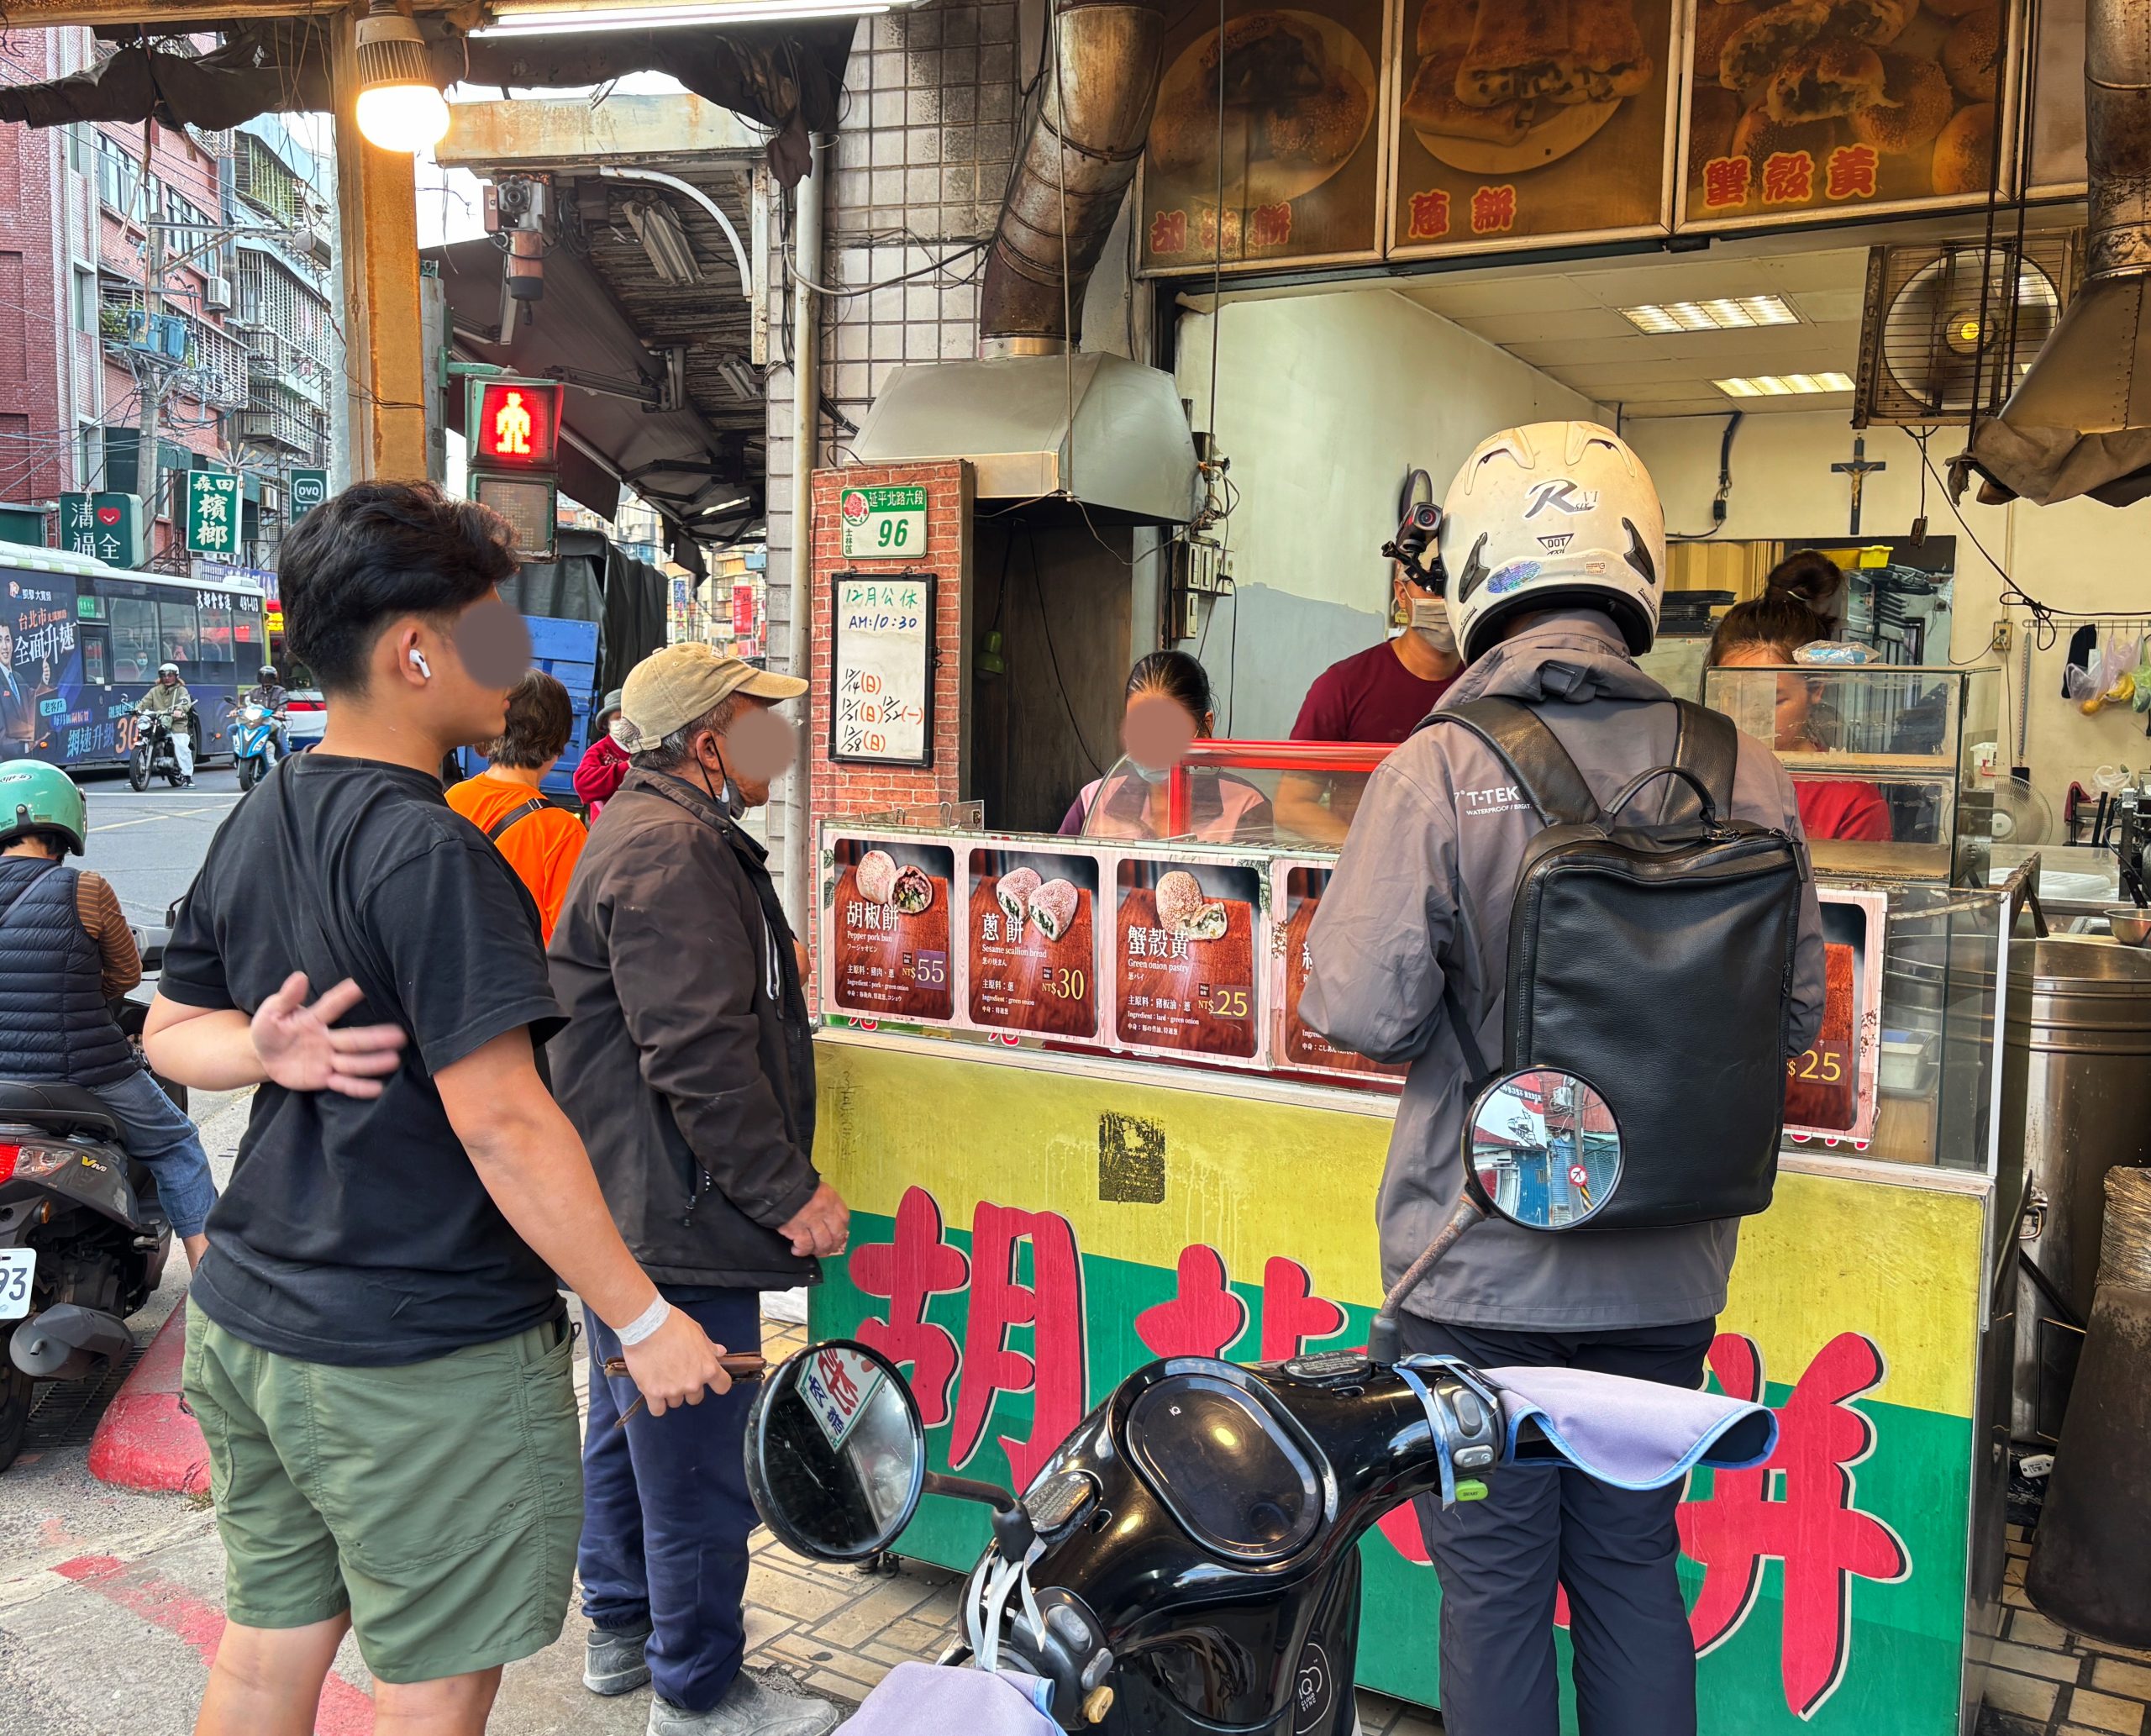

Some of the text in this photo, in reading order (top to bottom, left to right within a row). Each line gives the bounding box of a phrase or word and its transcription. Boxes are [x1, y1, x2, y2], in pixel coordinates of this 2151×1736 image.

[193, 474, 235, 492] 森田
[869, 490, 923, 507] 延平北路六段
[196, 494, 229, 550] 檳榔
[877, 518, 909, 548] 96
[1548, 538, 1565, 548] DOT
[845, 587, 918, 609] 12月公休
[846, 901, 899, 932] 胡椒餅
[847, 931, 892, 943] Pepper pork bun
[981, 944, 1047, 958] Sesame scallion bread
[1128, 959, 1190, 975] Green onion pastry
